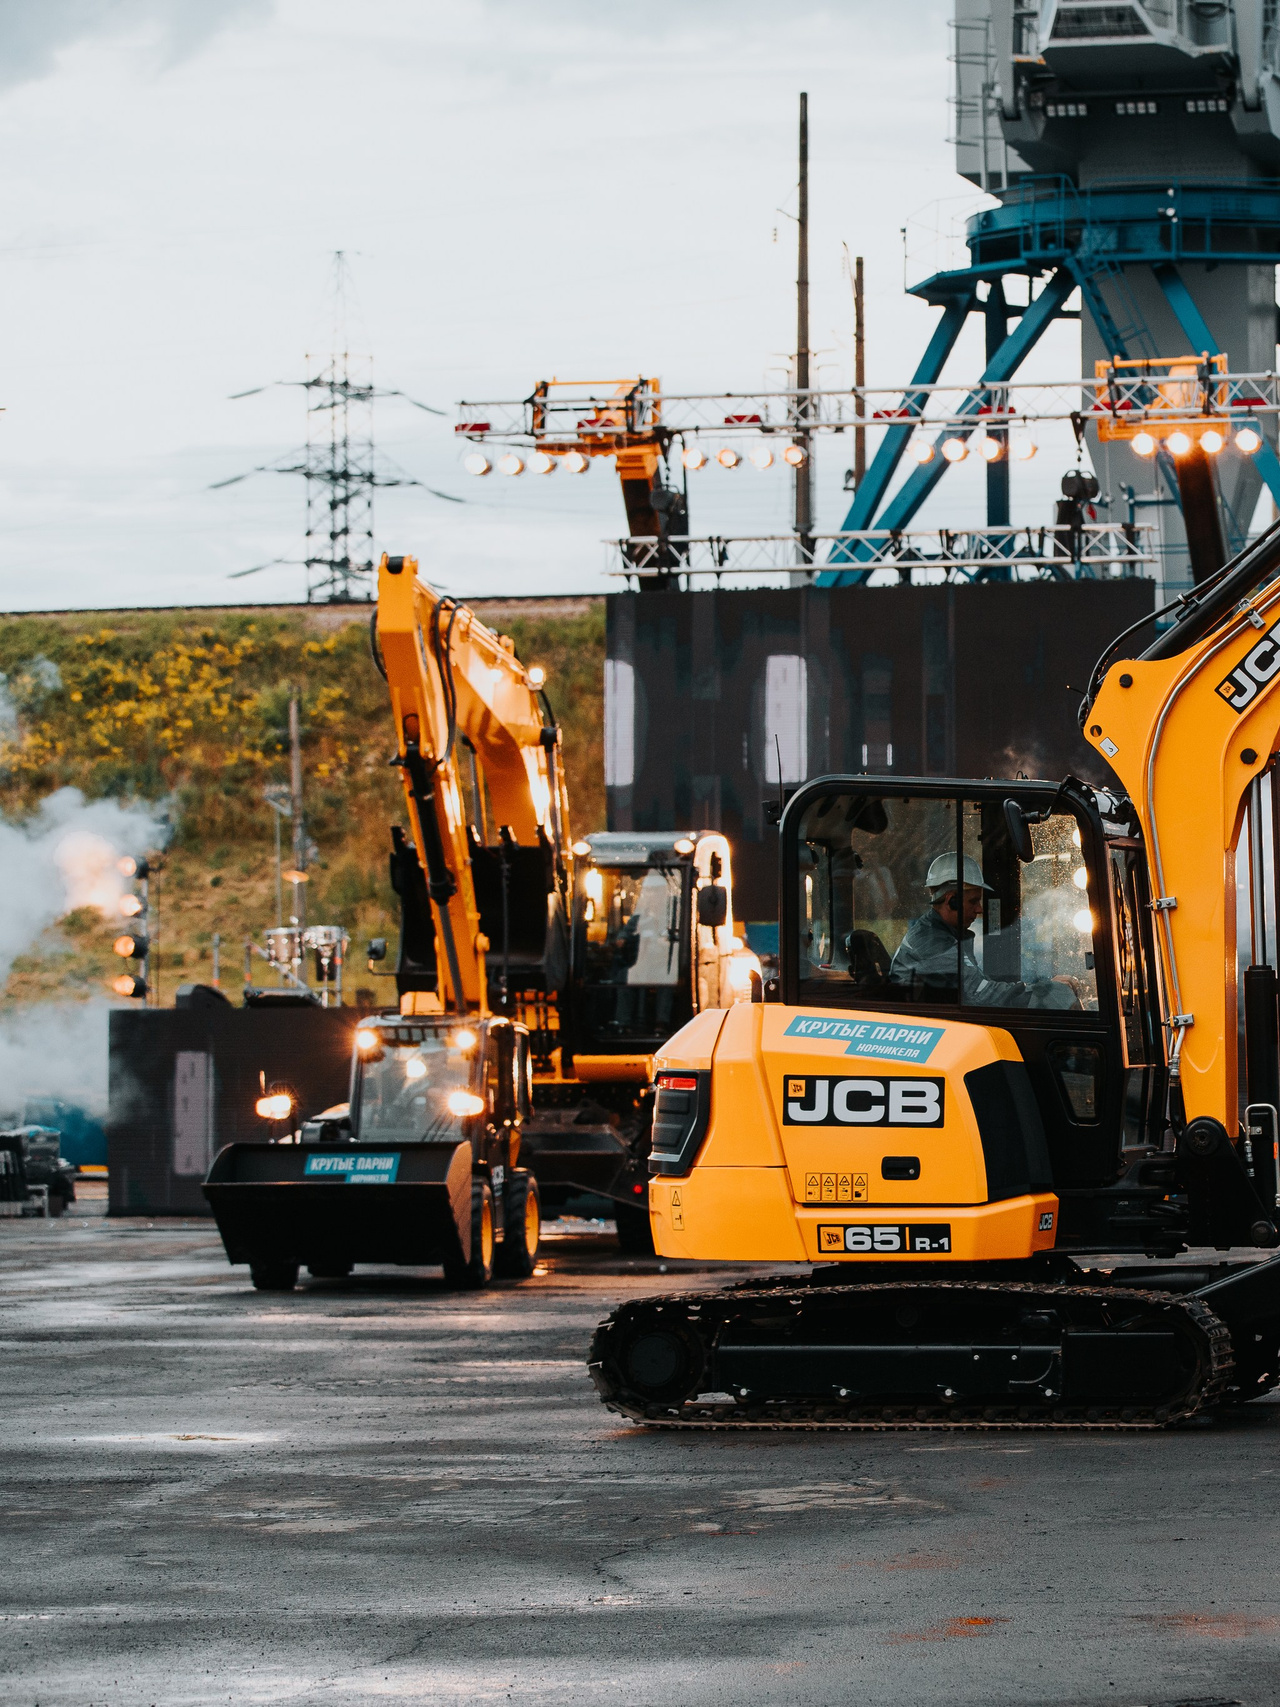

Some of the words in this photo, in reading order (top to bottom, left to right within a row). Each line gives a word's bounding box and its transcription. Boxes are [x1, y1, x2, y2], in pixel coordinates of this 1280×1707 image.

[795, 1020, 871, 1038] КРУТЫЕ
[870, 1026, 933, 1045] ПАРНИ
[856, 1043, 921, 1058] НОРНИКЕЛЯ
[787, 1079, 941, 1123] JCB
[310, 1158, 355, 1171] КРУТЫЕ
[356, 1157, 394, 1170] ПАРНИ
[1039, 1213, 1053, 1230] JCB
[826, 1233, 840, 1244] JCB
[845, 1226, 901, 1251] 65
[915, 1237, 949, 1251] R-1
